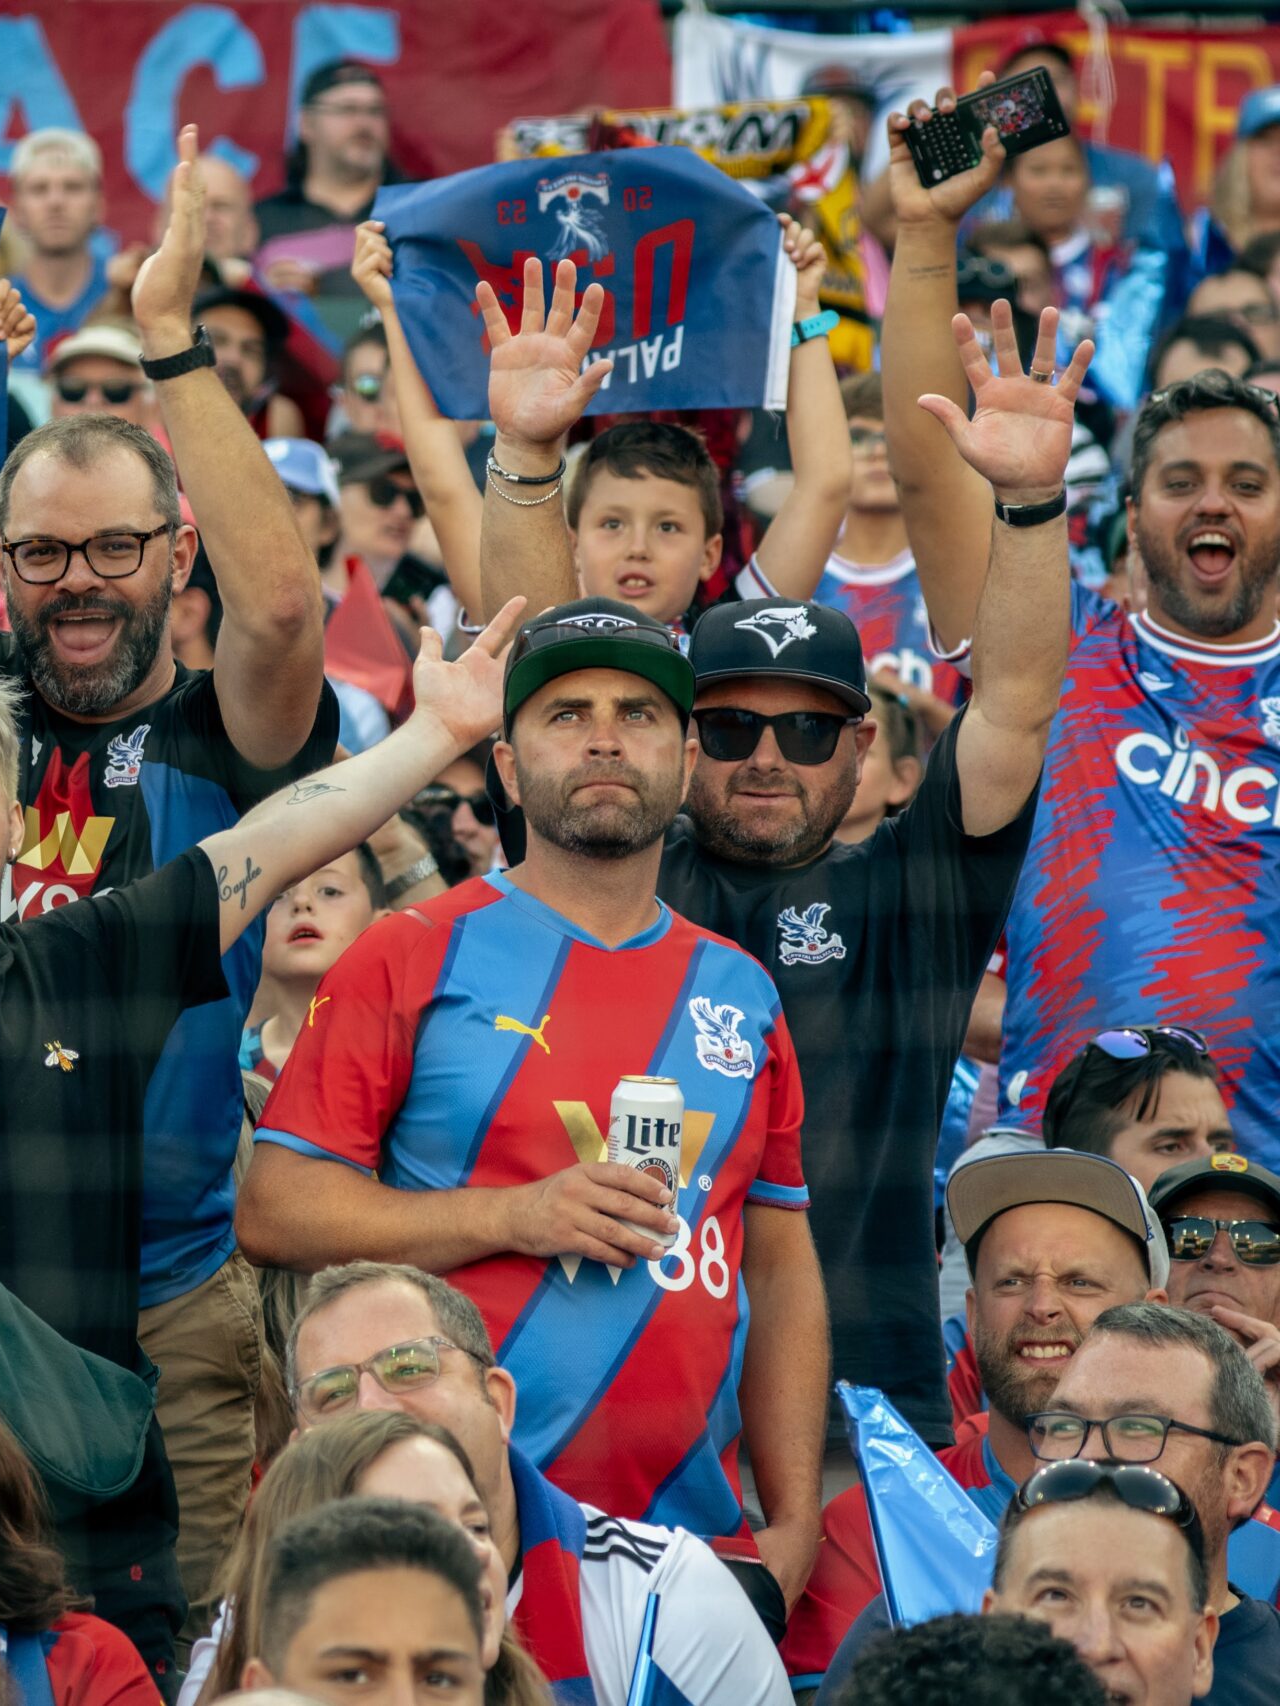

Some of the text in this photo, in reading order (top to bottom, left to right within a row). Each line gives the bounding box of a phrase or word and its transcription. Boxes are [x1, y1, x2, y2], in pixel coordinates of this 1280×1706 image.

[582, 326, 685, 390] PALA
[1115, 724, 1280, 828] cinc
[623, 1114, 681, 1156] Lite
